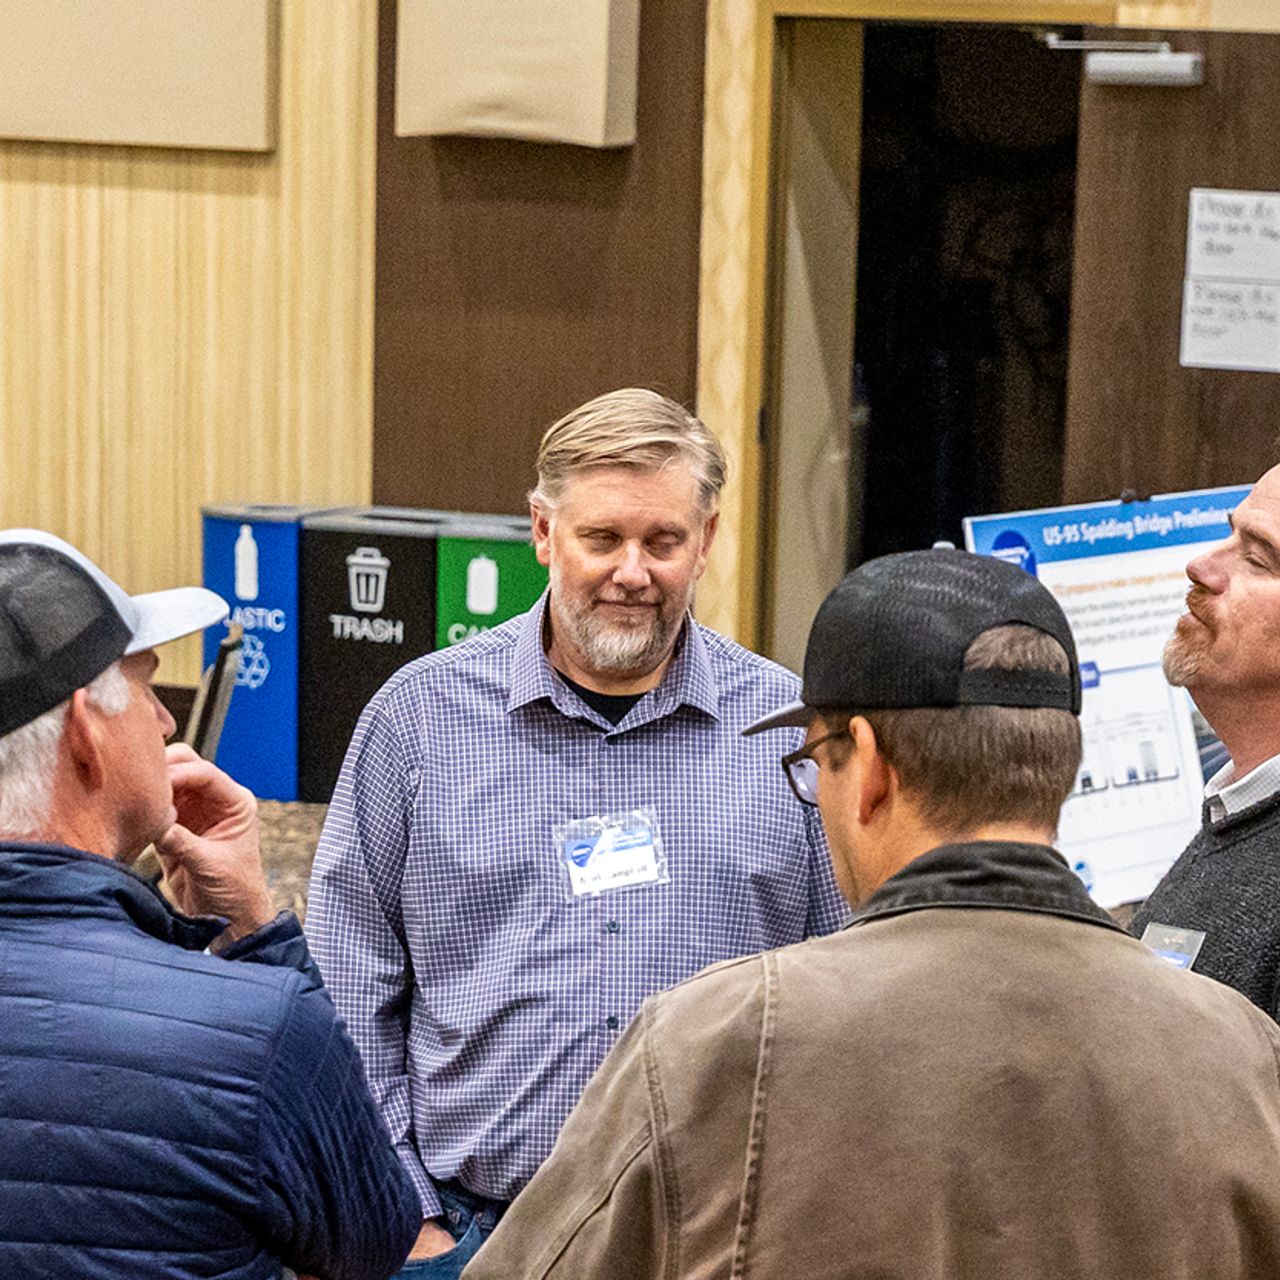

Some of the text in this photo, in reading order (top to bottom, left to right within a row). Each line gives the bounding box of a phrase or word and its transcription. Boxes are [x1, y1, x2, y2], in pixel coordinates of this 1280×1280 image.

[1042, 524, 1080, 546] US-95
[1081, 517, 1134, 544] Spalding
[1134, 511, 1173, 536] Bridge
[223, 606, 286, 632] LASTIC
[329, 613, 404, 644] TRASH
